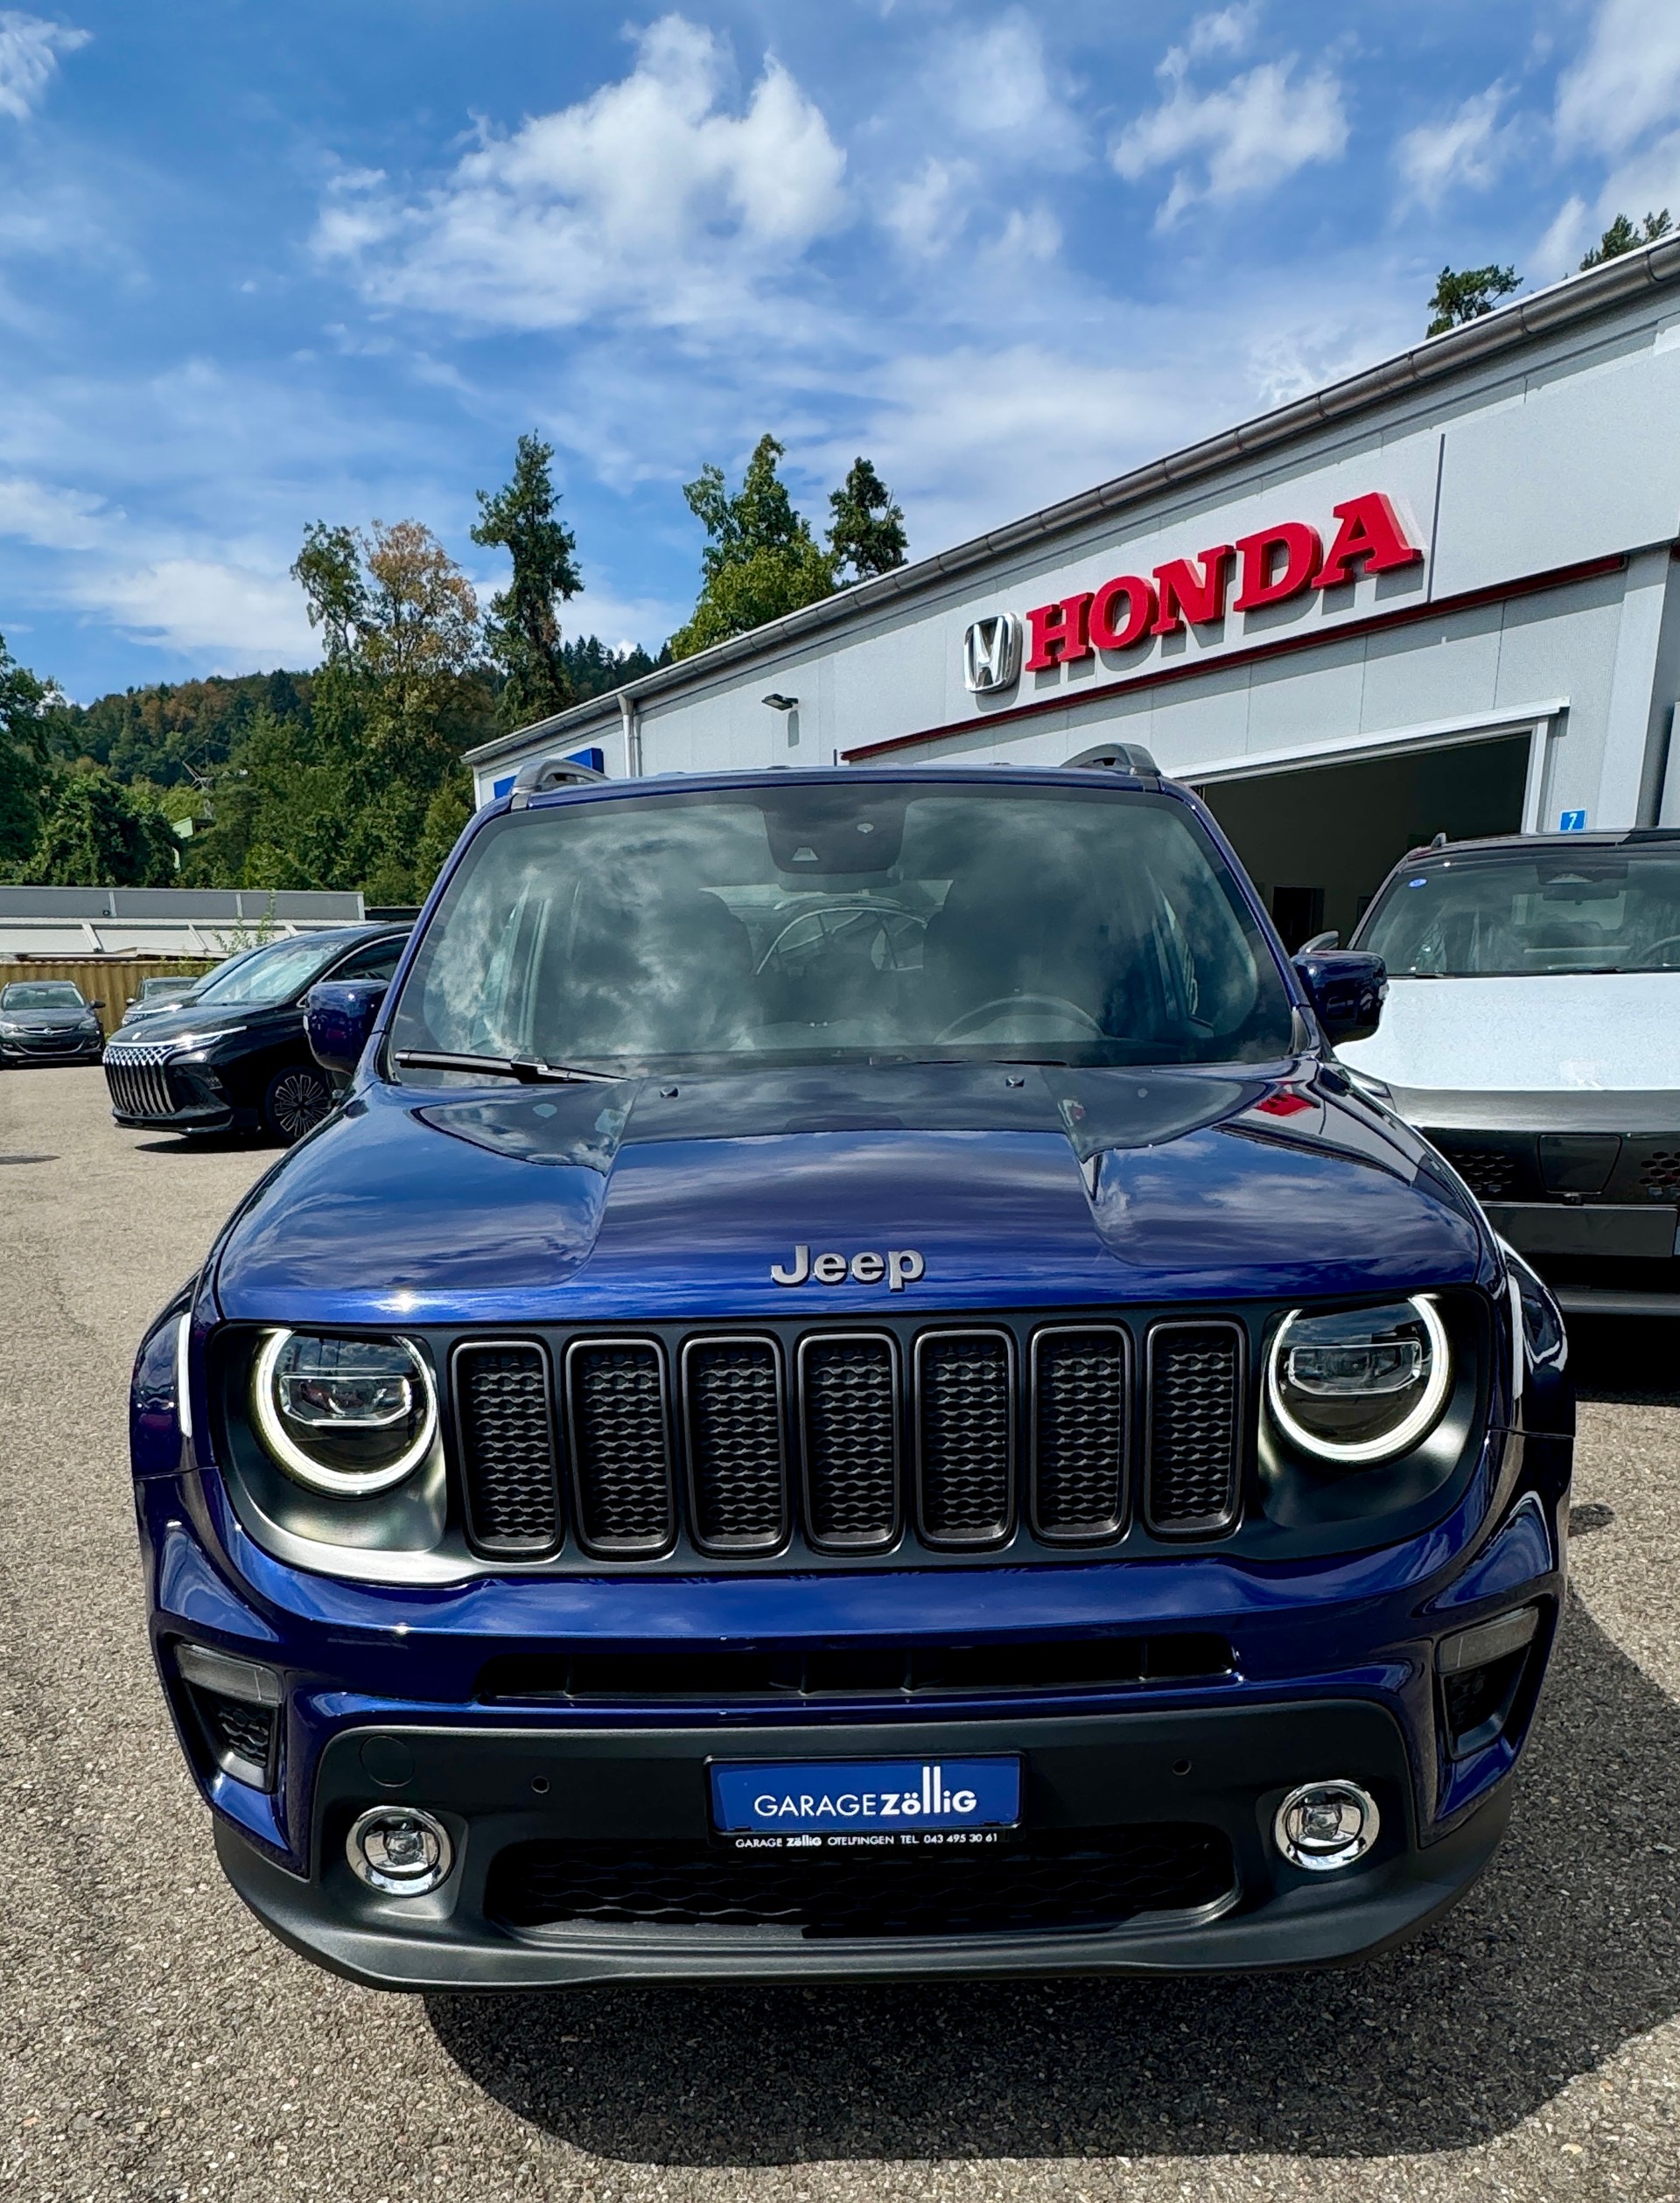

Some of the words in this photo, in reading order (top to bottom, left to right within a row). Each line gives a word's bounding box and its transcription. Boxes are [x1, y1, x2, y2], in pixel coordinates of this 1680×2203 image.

[1024, 492, 1423, 673] HONDA
[1568, 812, 1578, 831] 7
[770, 1244, 925, 1292] Jeep
[735, 1838, 782, 1848] GARAGE
[827, 1835, 894, 1845] OTELFINGEN
[900, 1835, 920, 1844] TEL
[923, 1834, 944, 1843] 043
[946, 1833, 967, 1843] 495
[969, 1833, 984, 1843] 30
[985, 1832, 998, 1843] 61
